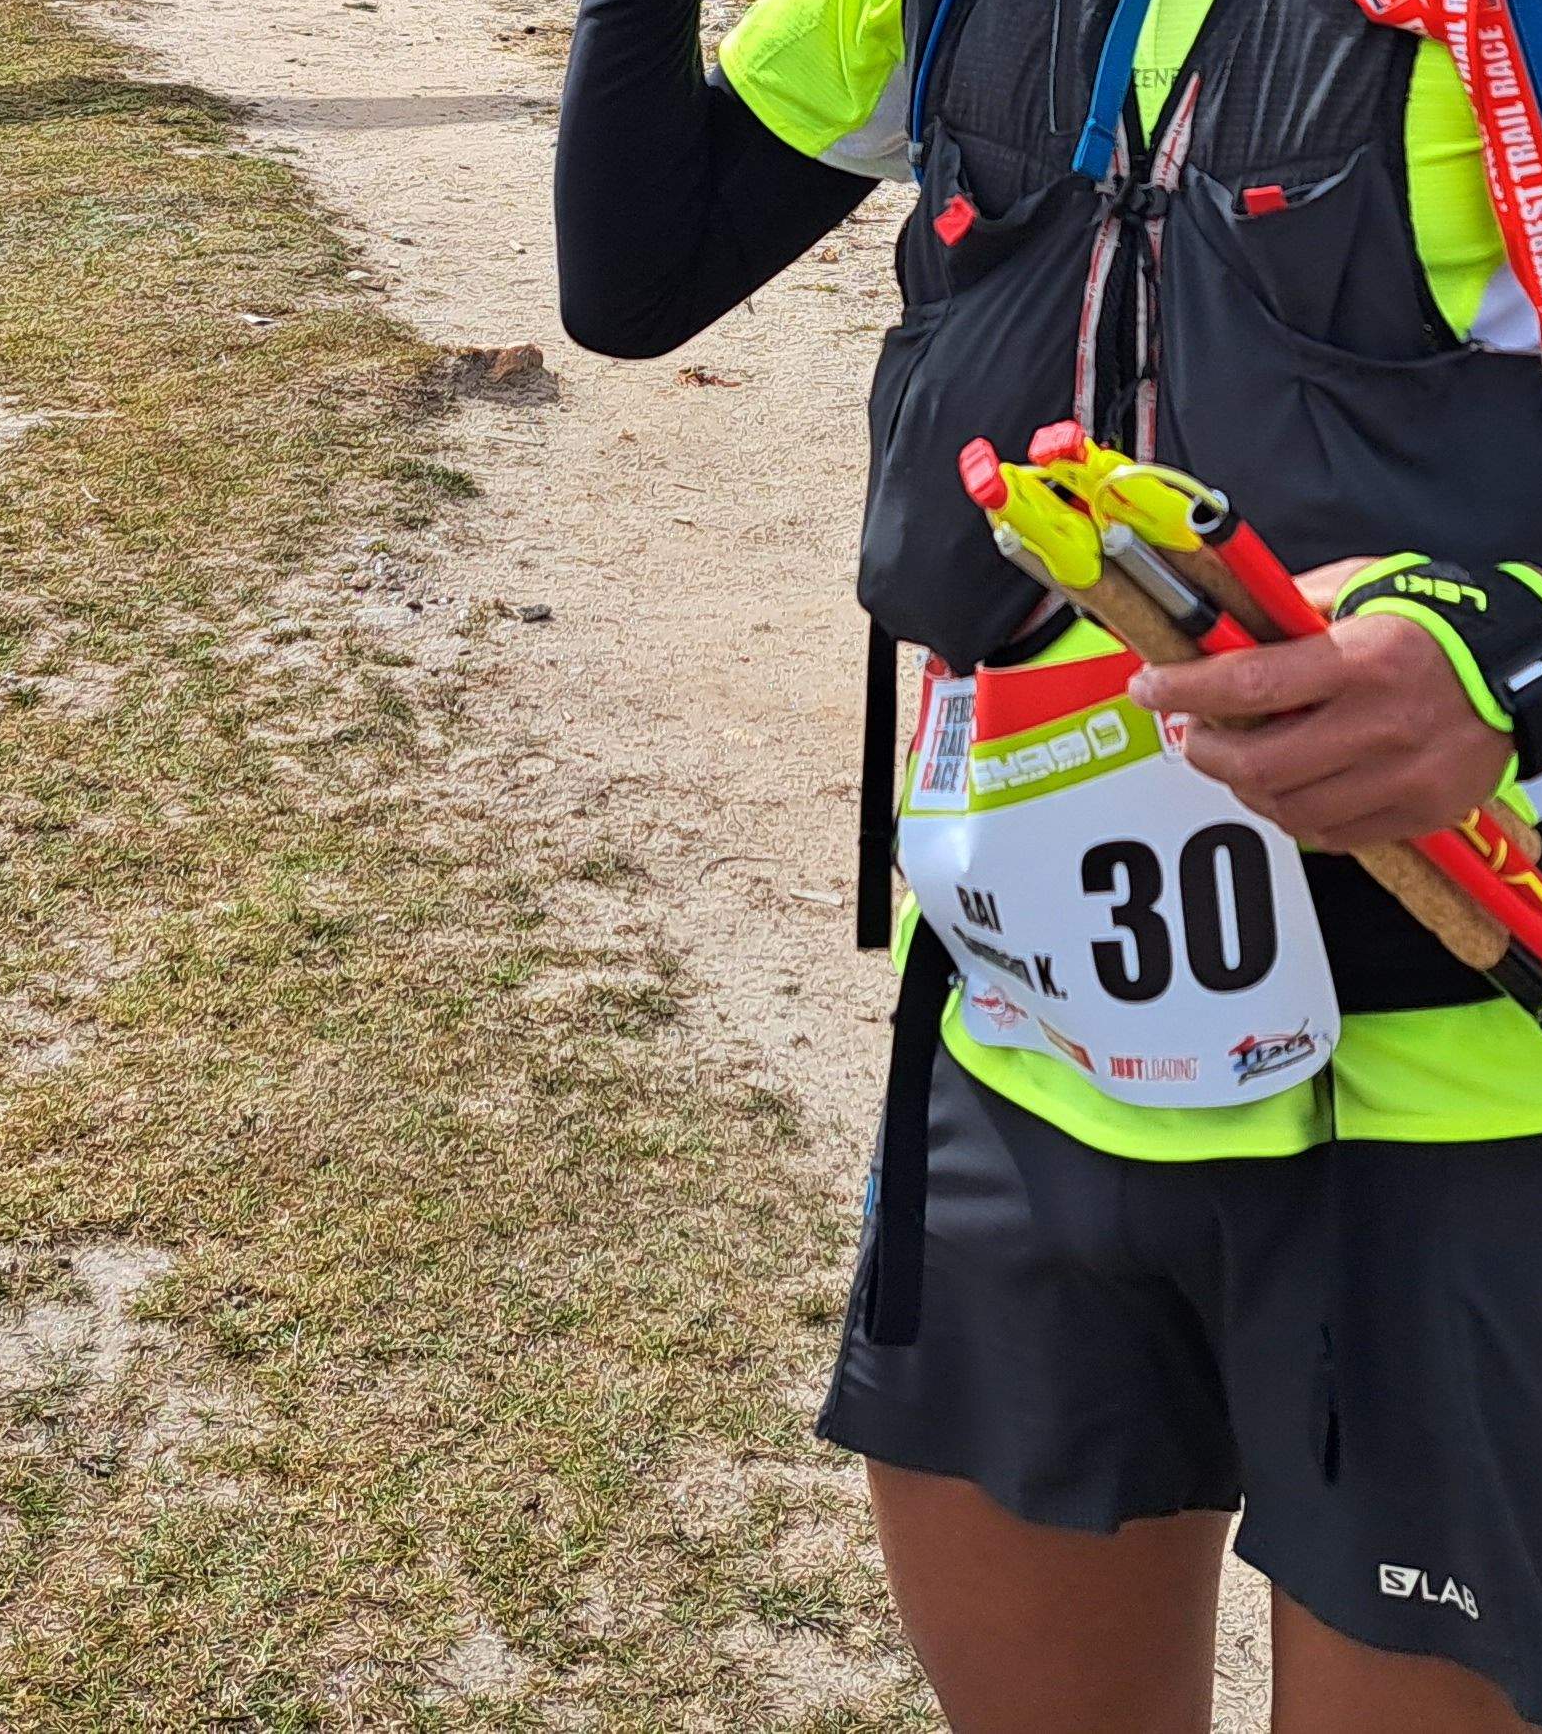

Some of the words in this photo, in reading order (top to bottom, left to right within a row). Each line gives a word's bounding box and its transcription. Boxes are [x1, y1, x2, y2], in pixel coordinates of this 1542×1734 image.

[1477, 24, 1522, 99] RACE
[1493, 100, 1542, 183] TRAIL
[955, 883, 1004, 935] RAI
[1080, 821, 1278, 1005] 30
